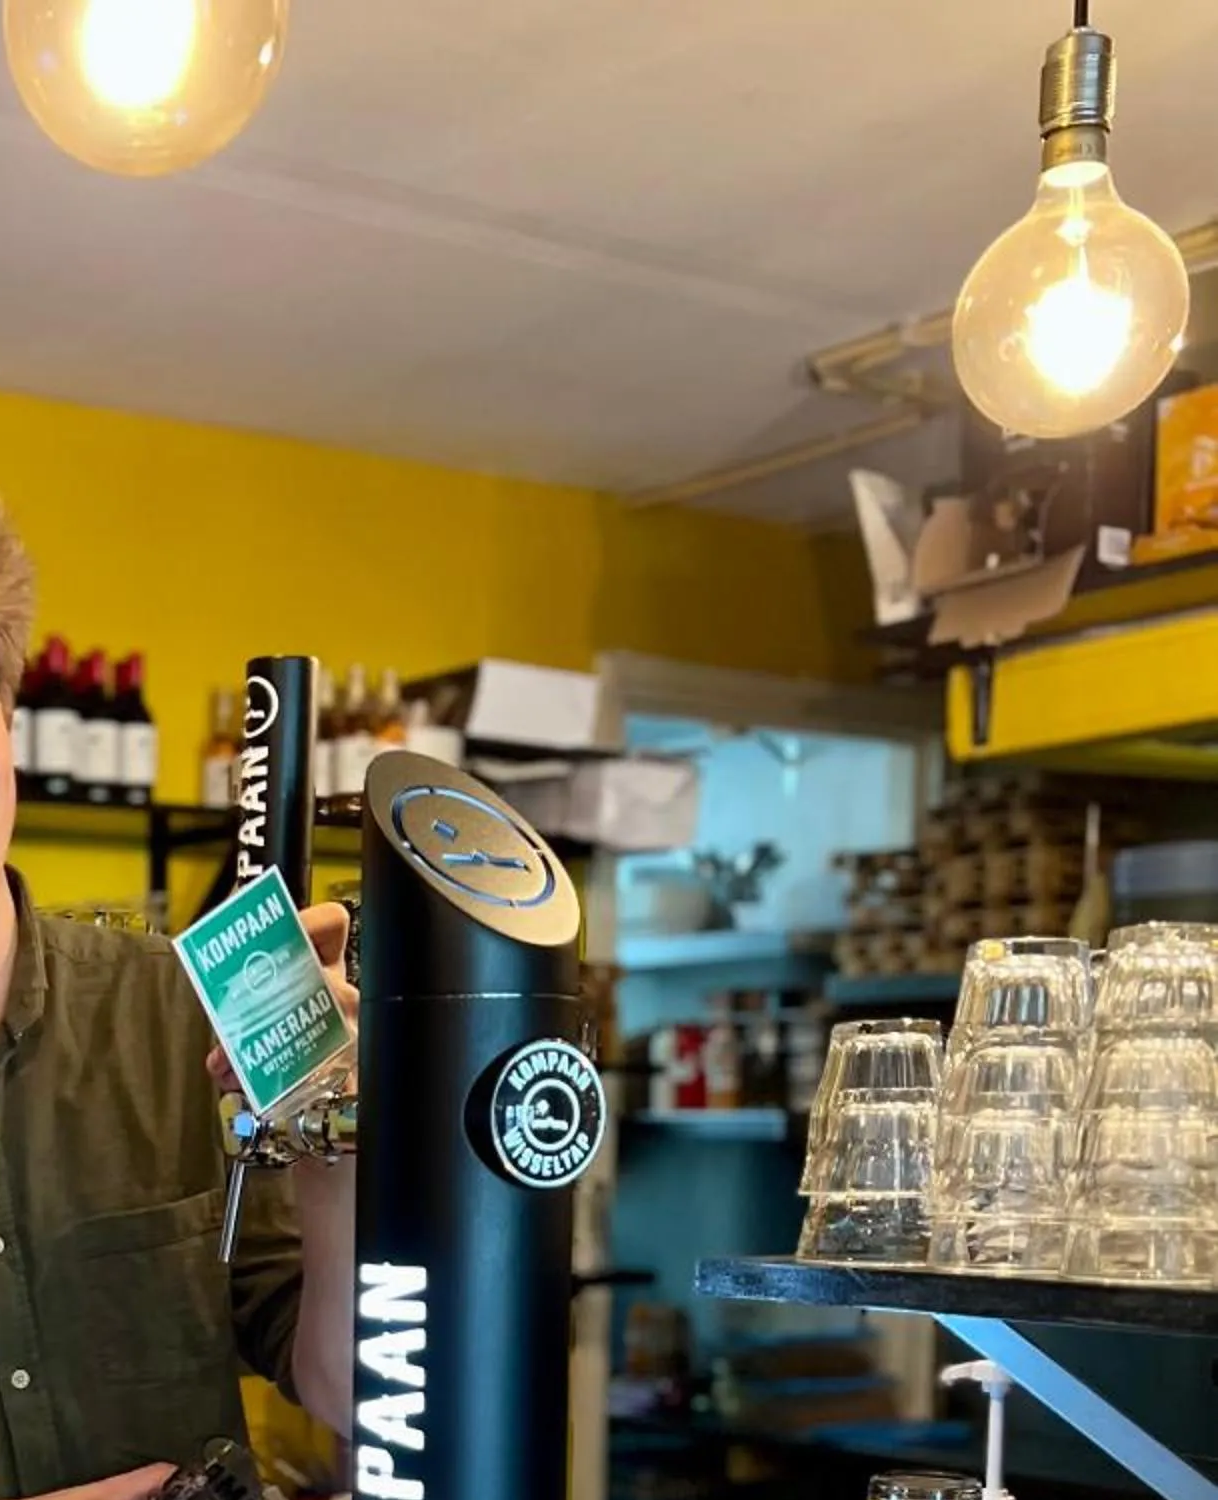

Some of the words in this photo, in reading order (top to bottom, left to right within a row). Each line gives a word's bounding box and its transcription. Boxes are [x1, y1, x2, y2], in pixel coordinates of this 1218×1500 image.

[197, 893, 284, 973] KOMPAAN
[240, 989, 332, 1071] KAMERAAD
[508, 1051, 592, 1091] KOMPAAN
[502, 1126, 591, 1177] WISSELTAP
